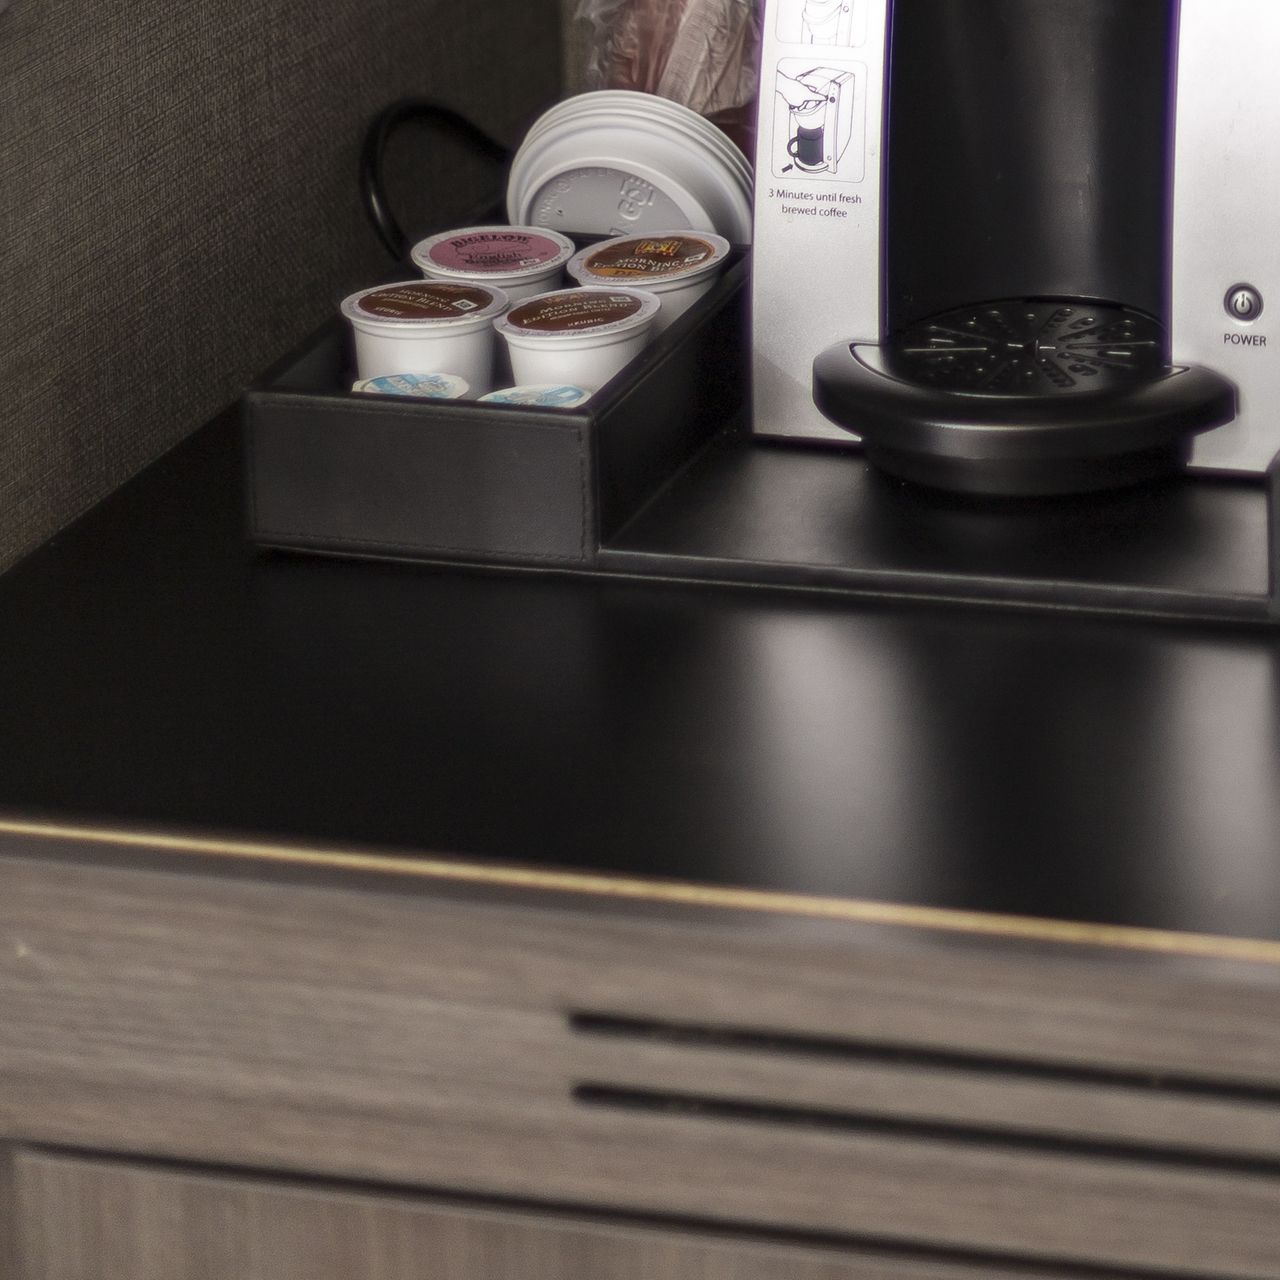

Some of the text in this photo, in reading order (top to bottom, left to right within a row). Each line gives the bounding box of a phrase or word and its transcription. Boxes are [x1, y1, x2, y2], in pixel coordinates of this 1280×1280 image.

[768, 188, 862, 204] 3 Minutes until fresh
[781, 205, 848, 218] brewed coffee
[1224, 333, 1267, 347] POWER
